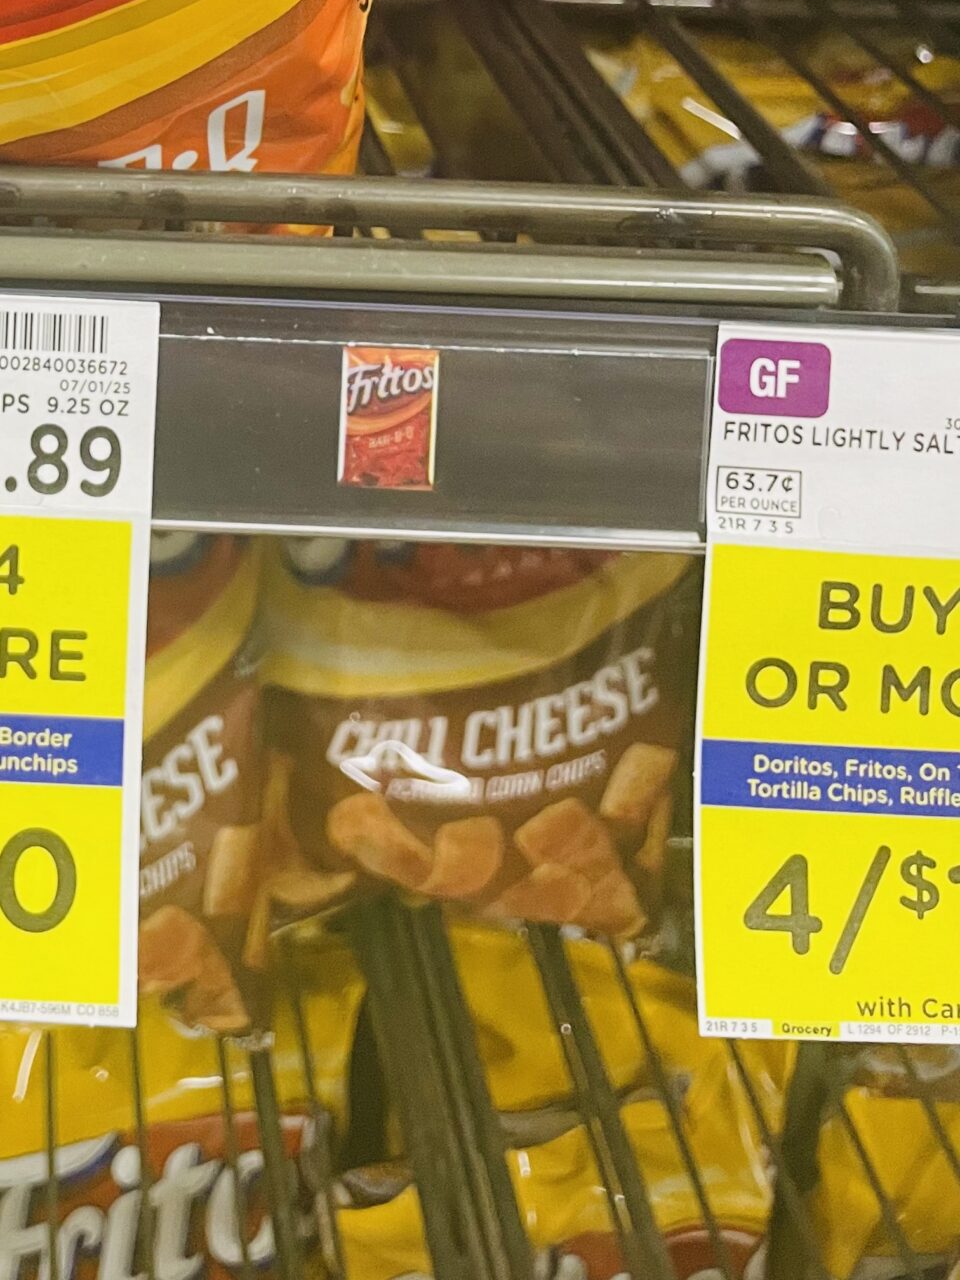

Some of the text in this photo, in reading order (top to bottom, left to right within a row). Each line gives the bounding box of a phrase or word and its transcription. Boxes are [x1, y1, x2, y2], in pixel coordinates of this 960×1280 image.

[59, 379, 131, 395] 07/01/25
[749, 357, 801, 398] GF
[47, 396, 91, 415] 9.25
[99, 399, 129, 417] OZ
[724, 421, 803, 445] FRITOS
[812, 427, 906, 451] LIGHTLY
[726, 471, 794, 493] 63.7¢
[721, 496, 797, 512] PER OUNCE
[818, 581, 960, 636] BUY
[745, 657, 851, 712] OR
[461, 646, 659, 769] CHEESE
[0, 726, 72, 748] Border
[753, 754, 838, 780] Doritos,
[845, 758, 913, 783] Fritos,
[919, 763, 950, 781] On
[140, 715, 239, 852] ESE
[747, 779, 822, 801] Tortilla
[828, 782, 893, 807] Chips,
[743, 845, 960, 975] 4/$
[857, 997, 911, 1017] with
[782, 1023, 832, 1037] Grocery
